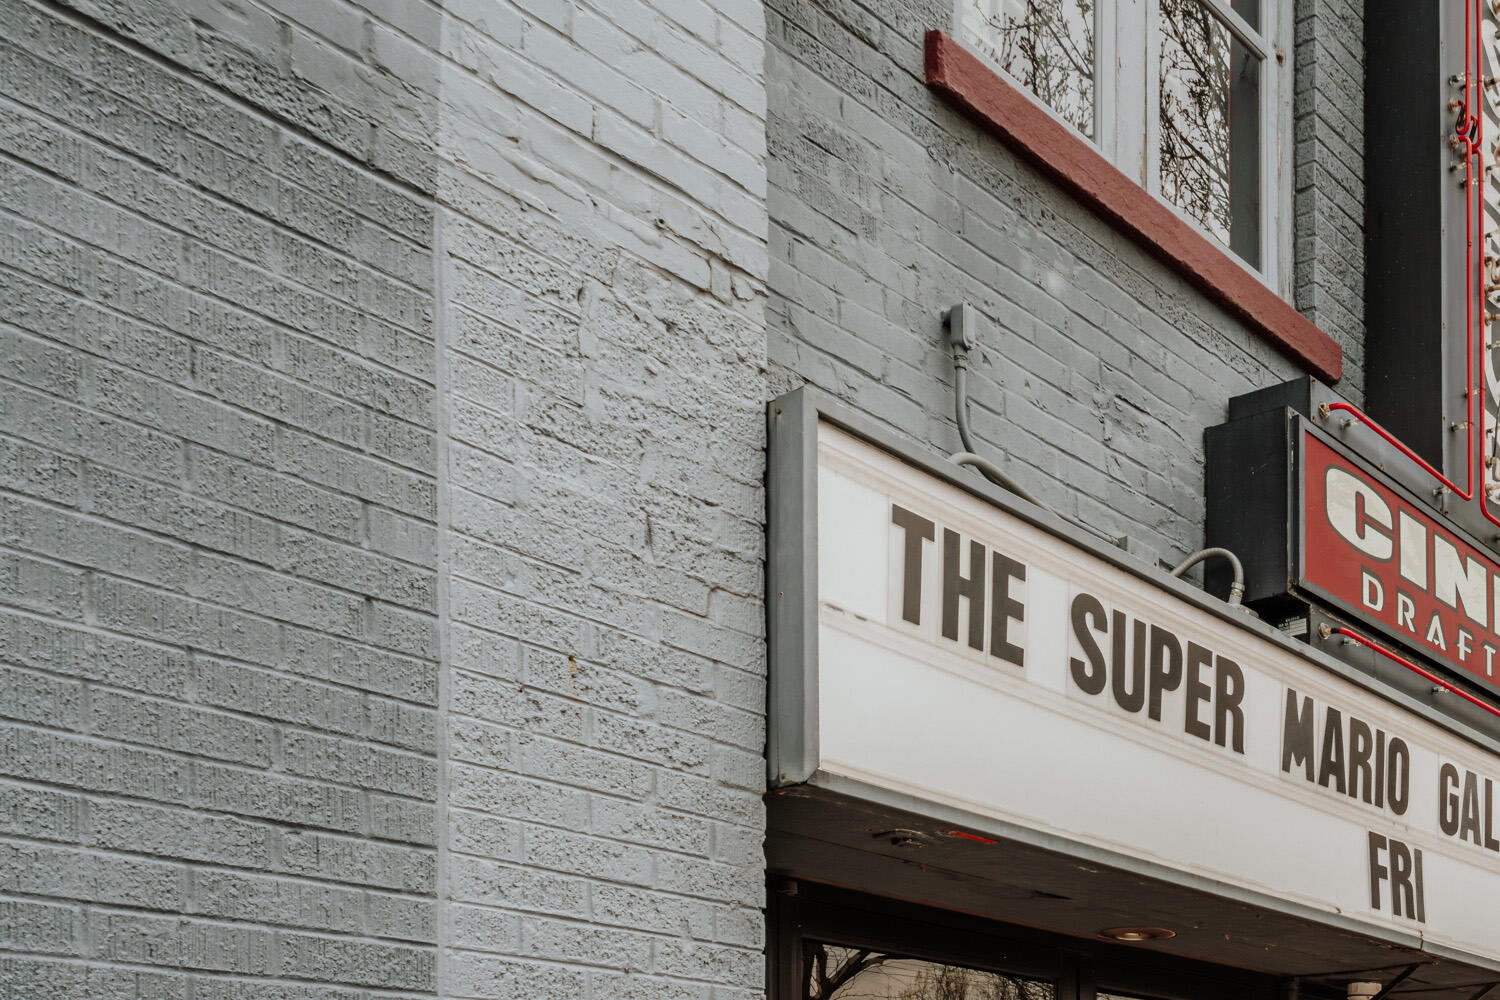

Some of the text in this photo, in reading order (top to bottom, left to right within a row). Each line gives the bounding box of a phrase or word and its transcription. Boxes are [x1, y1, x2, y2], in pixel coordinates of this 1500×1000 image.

[892, 503, 1027, 668] THE
[1069, 592, 1245, 755] SUPER
[1281, 687, 1411, 817] MARIO
[1368, 830, 1426, 924] FRI
